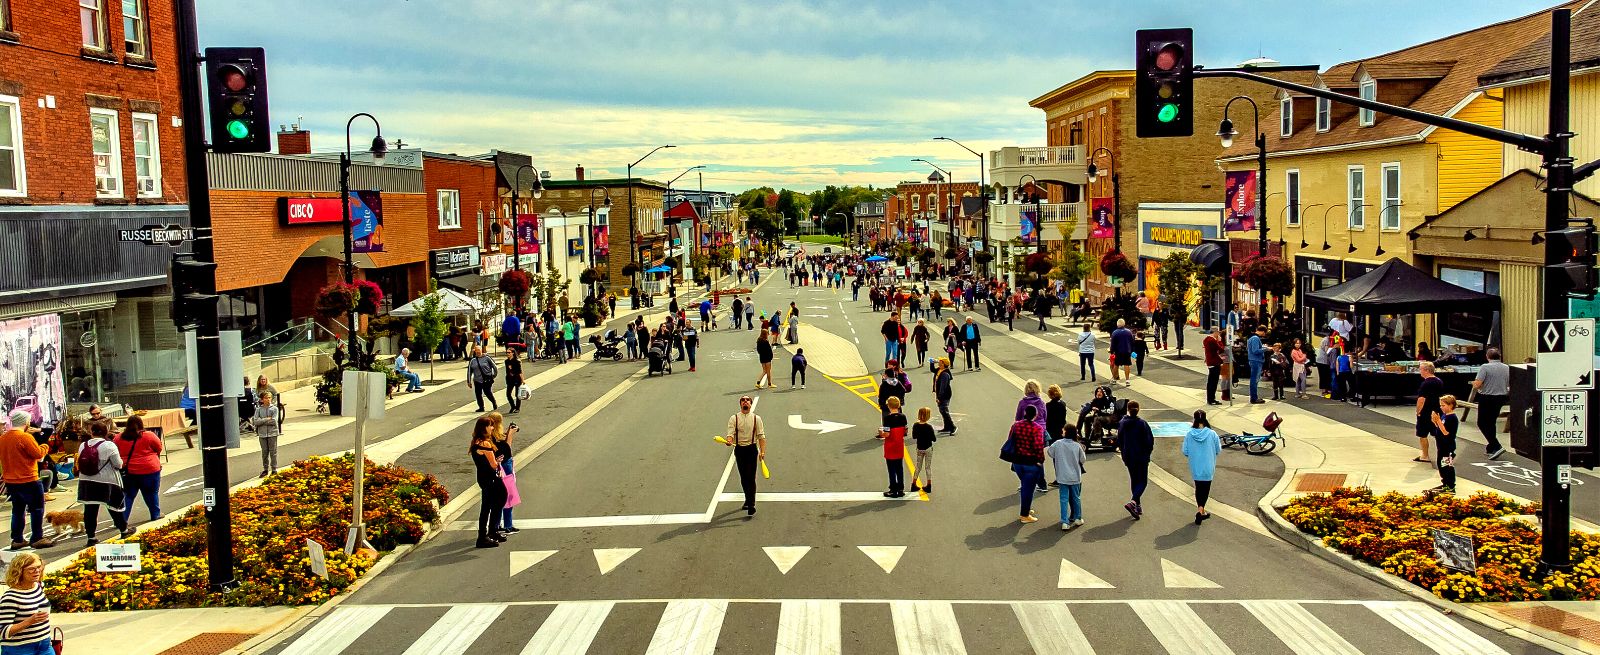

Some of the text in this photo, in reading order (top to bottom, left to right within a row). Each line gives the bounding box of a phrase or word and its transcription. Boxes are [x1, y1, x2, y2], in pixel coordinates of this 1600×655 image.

[1237, 183, 1246, 217] Explore
[290, 203, 306, 218] CIBC
[363, 209, 371, 232] Taste
[121, 230, 152, 241] RUSSE
[155, 229, 181, 241] BECKWITH
[1151, 226, 1173, 243] DOLLAR
[1176, 229, 1202, 246] WORLD
[1549, 393, 1580, 403] KEEP
[1545, 430, 1584, 438] GARDEZ
[100, 554, 137, 562] WASHROOMS
